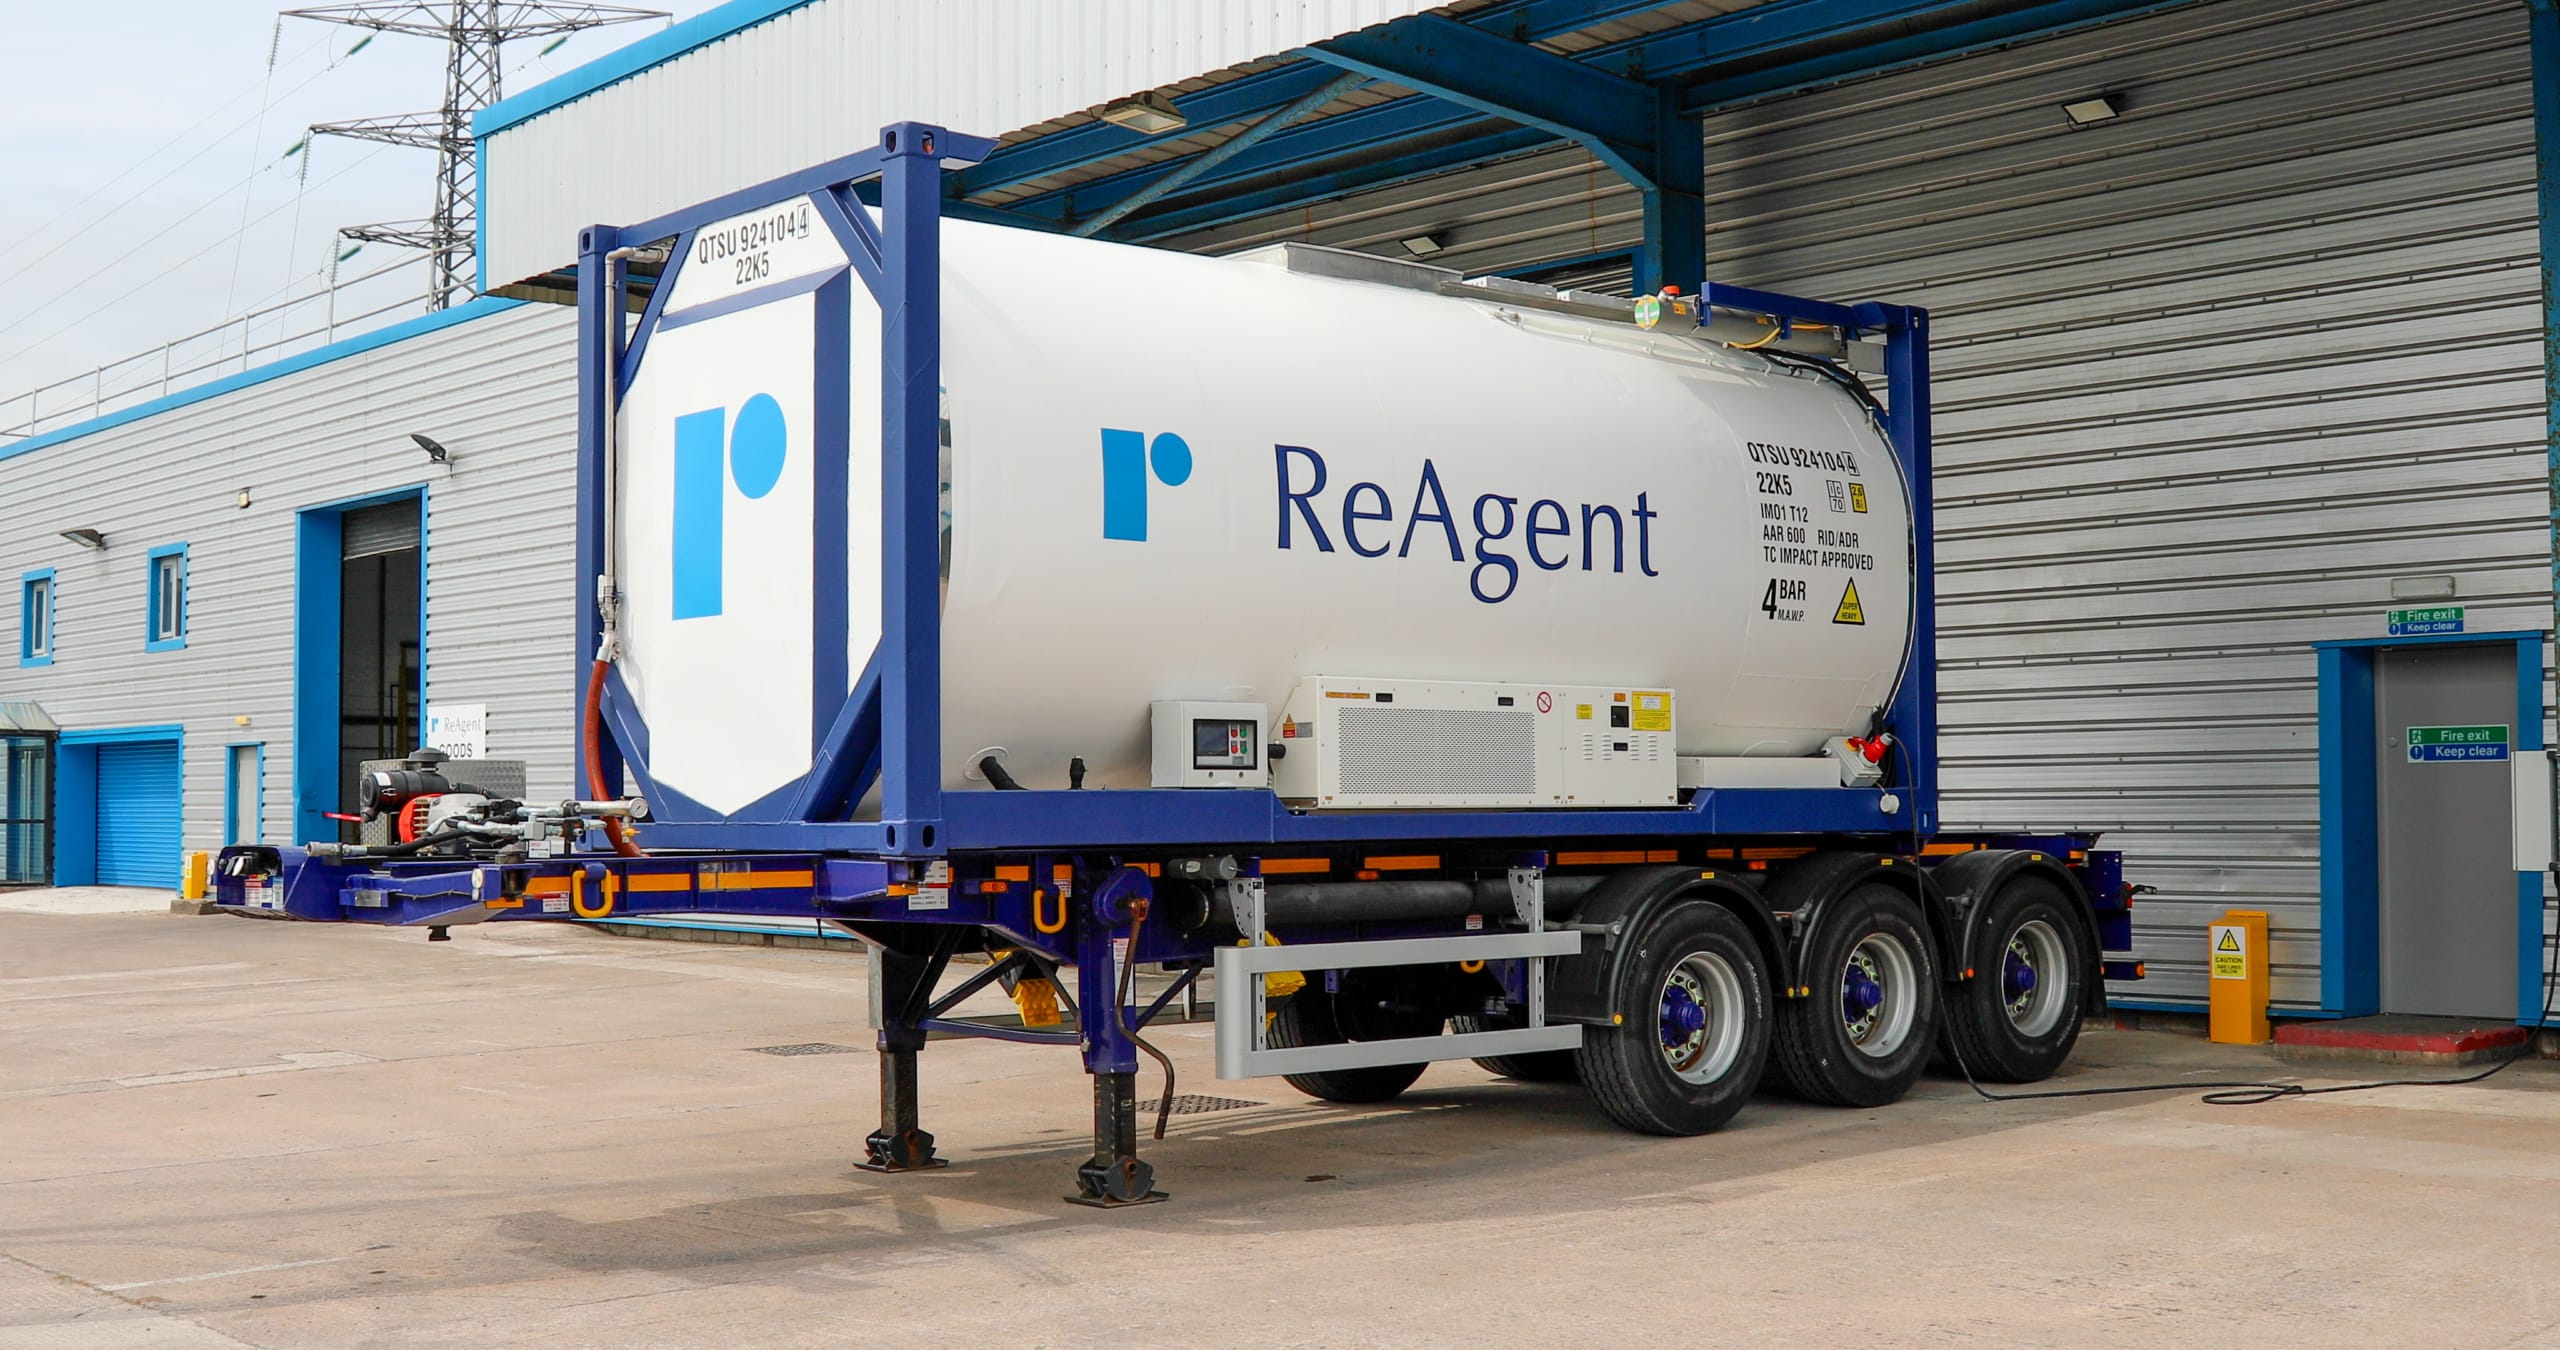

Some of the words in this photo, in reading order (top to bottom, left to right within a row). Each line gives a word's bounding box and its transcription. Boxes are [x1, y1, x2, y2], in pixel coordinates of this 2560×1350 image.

[699, 228, 736, 265] QTSU
[740, 211, 796, 252] 924104
[736, 250, 770, 285] 22K5
[1747, 441, 1790, 466] QTSU
[1789, 447, 1846, 473] 924104
[1756, 471, 1793, 496] 22K5
[1789, 505, 1808, 523] T12
[1832, 498, 1843, 510] 70
[1274, 444, 1658, 603] ReAgent
[1763, 524, 1784, 542] AAR
[1786, 526, 1805, 544] 600
[1818, 529, 1859, 549] RID/ADR
[1763, 545, 1777, 563] TC
[1780, 547, 1818, 566] IMPACT
[1821, 550, 1874, 571] APPROVED
[1762, 578, 1777, 620] 4
[1779, 578, 1806, 601] BAR
[2407, 610, 2430, 621] Fire
[2433, 608, 2456, 620] exit
[2407, 623, 2430, 632] Keep
[2432, 622, 2456, 631] clear
[444, 717, 481, 737] ReAgent
[2441, 730, 2464, 741] Fire
[2467, 729, 2490, 741] exit
[2435, 746, 2465, 758] Keep
[2469, 745, 2498, 757] clear
